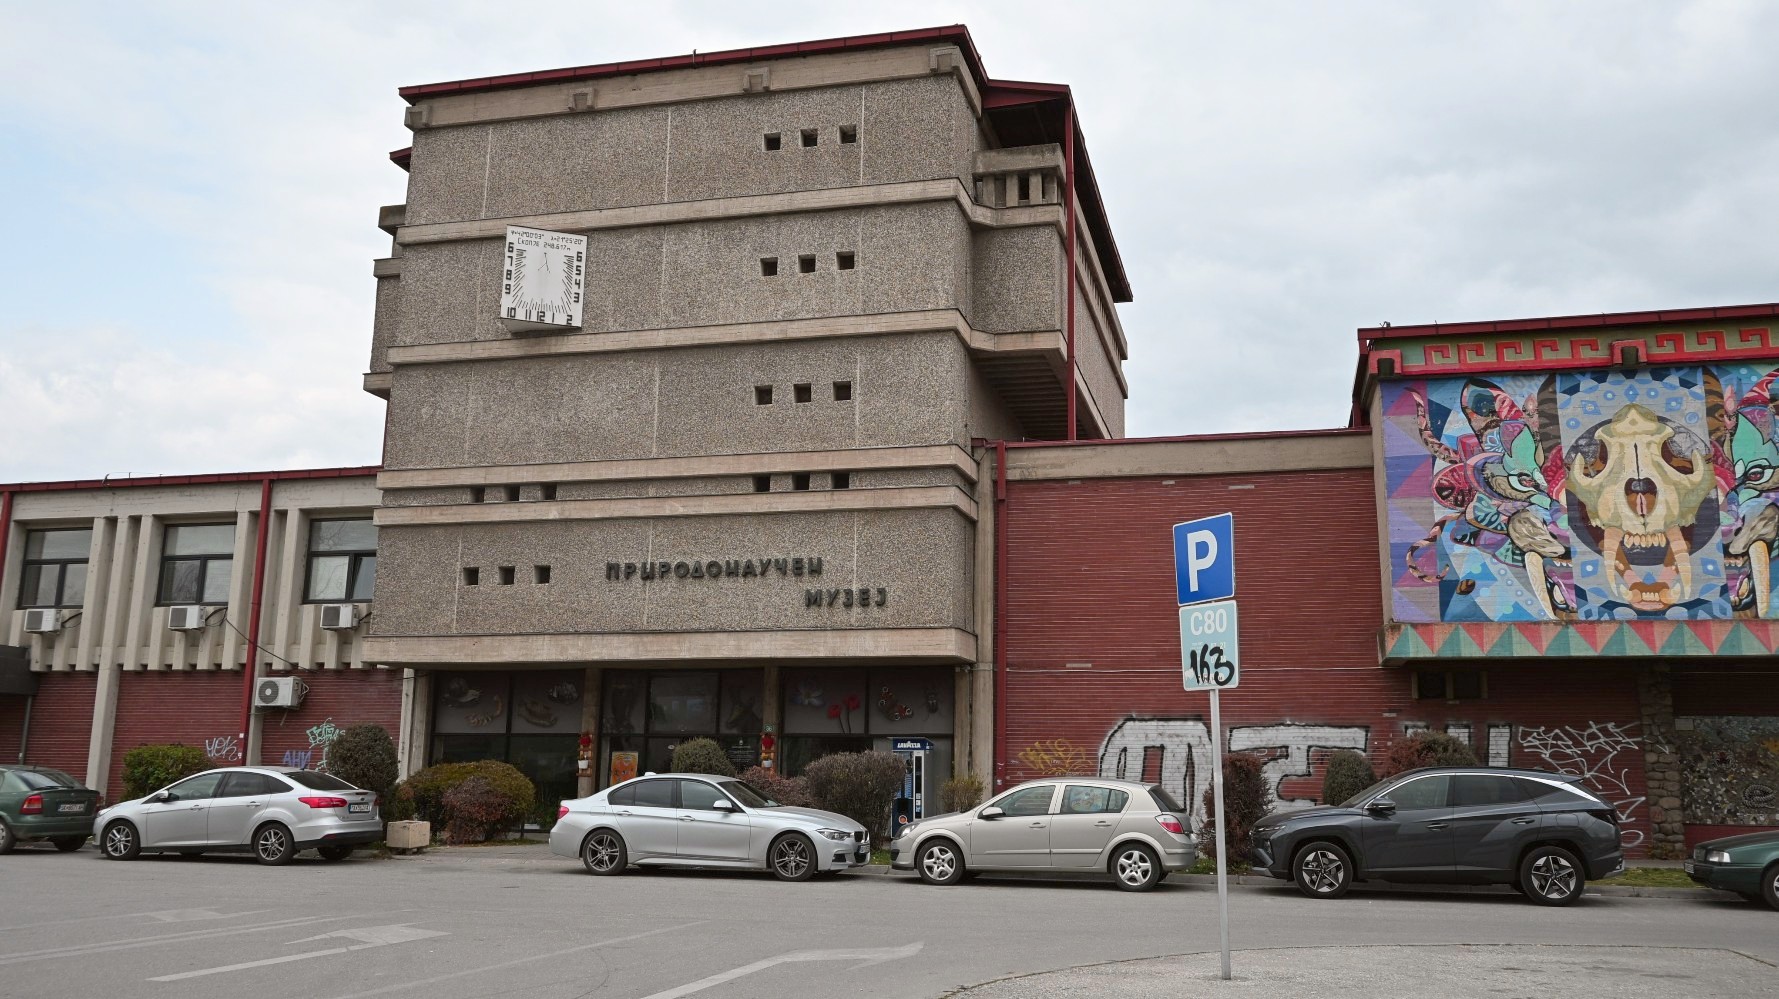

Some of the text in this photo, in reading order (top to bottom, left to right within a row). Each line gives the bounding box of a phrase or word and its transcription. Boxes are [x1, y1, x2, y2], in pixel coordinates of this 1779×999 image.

[507, 241, 514, 253] 6
[507, 255, 514, 266] 7
[576, 251, 582, 262] 6
[505, 269, 512, 280] 8
[575, 265, 582, 276] 5
[504, 283, 511, 294] 9
[574, 278, 581, 289] 4
[573, 292, 580, 303] 3
[506, 306, 516, 318] 10
[536, 310, 546, 322] 12
[566, 314, 573, 325] 2
[1186, 529, 1218, 593] P
[605, 556, 823, 581] ПРИРОДОНАУЧЕН
[804, 587, 887, 608] МУЗЕЈ
[1190, 608, 1228, 636] C80
